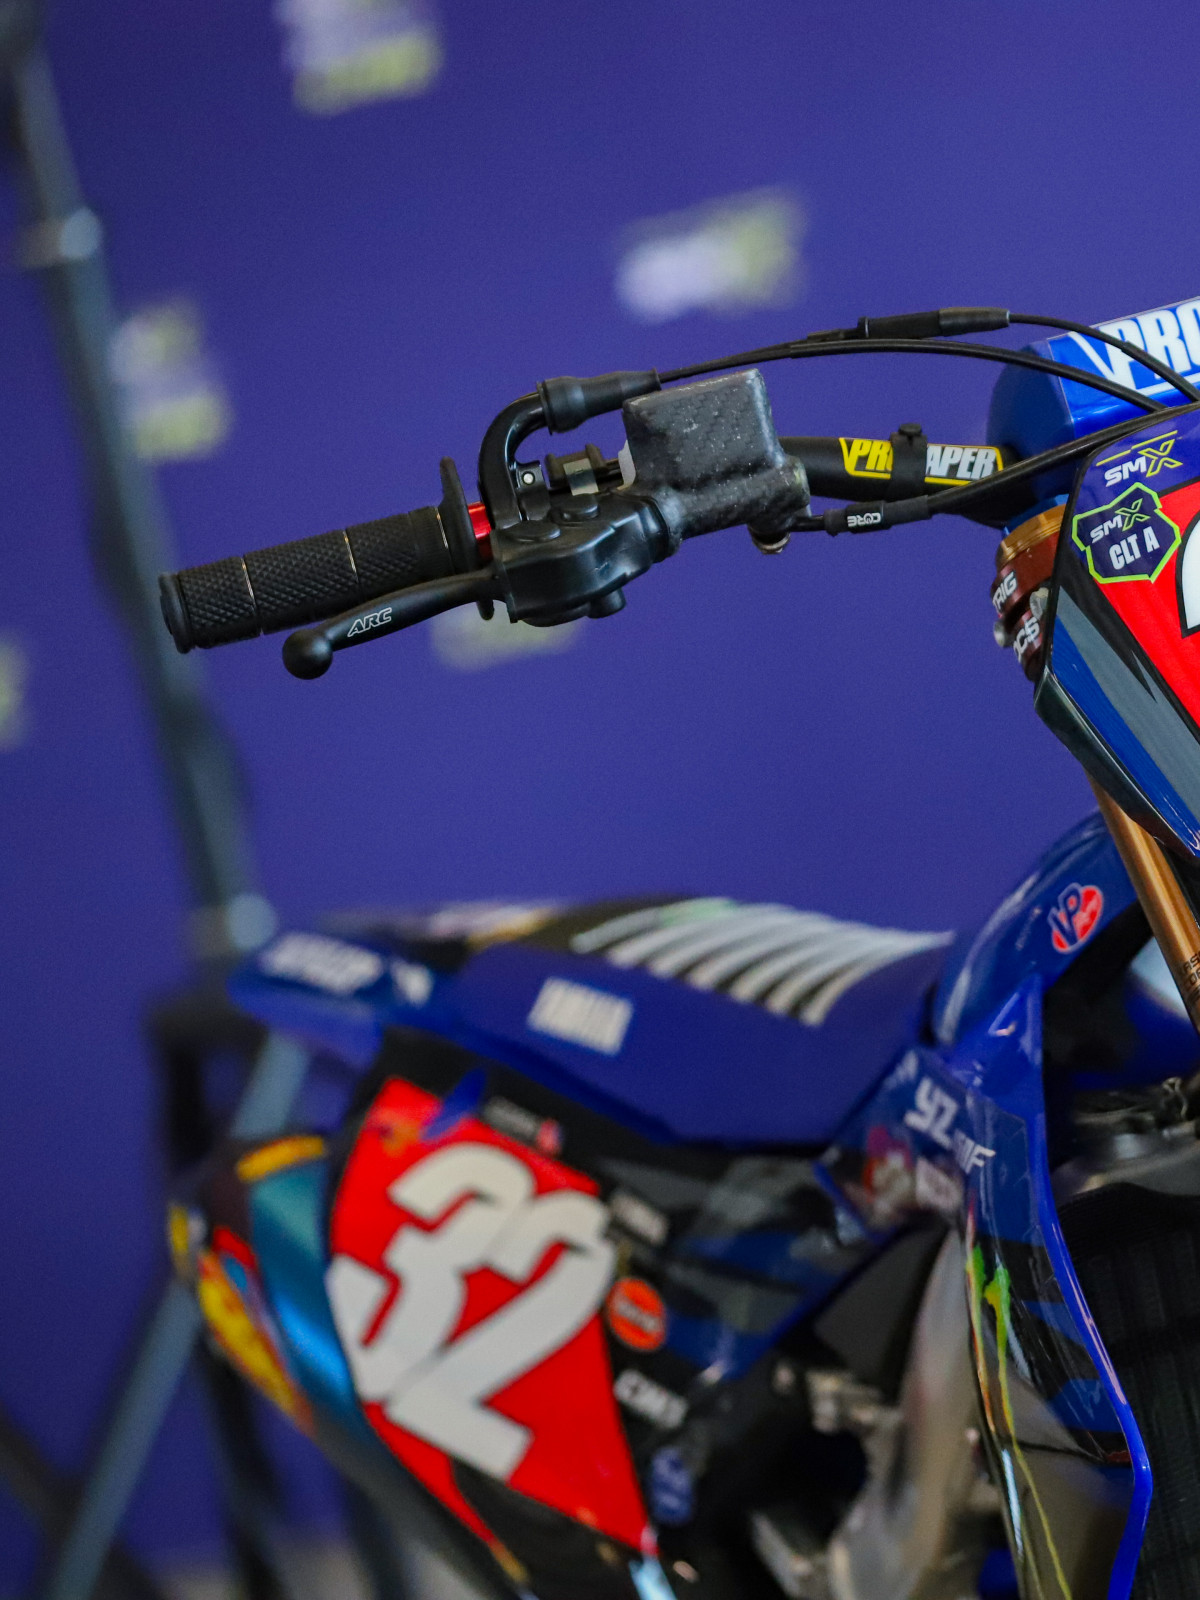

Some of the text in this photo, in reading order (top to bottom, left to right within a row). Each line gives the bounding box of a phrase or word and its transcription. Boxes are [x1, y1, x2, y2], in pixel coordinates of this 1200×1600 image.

[1104, 438, 1183, 488] SMX
[847, 512, 882, 528] CORE
[1089, 498, 1151, 543] SMX
[1109, 526, 1161, 570] CLT A
[347, 607, 392, 637] ARC
[325, 1139, 618, 1482] 32
